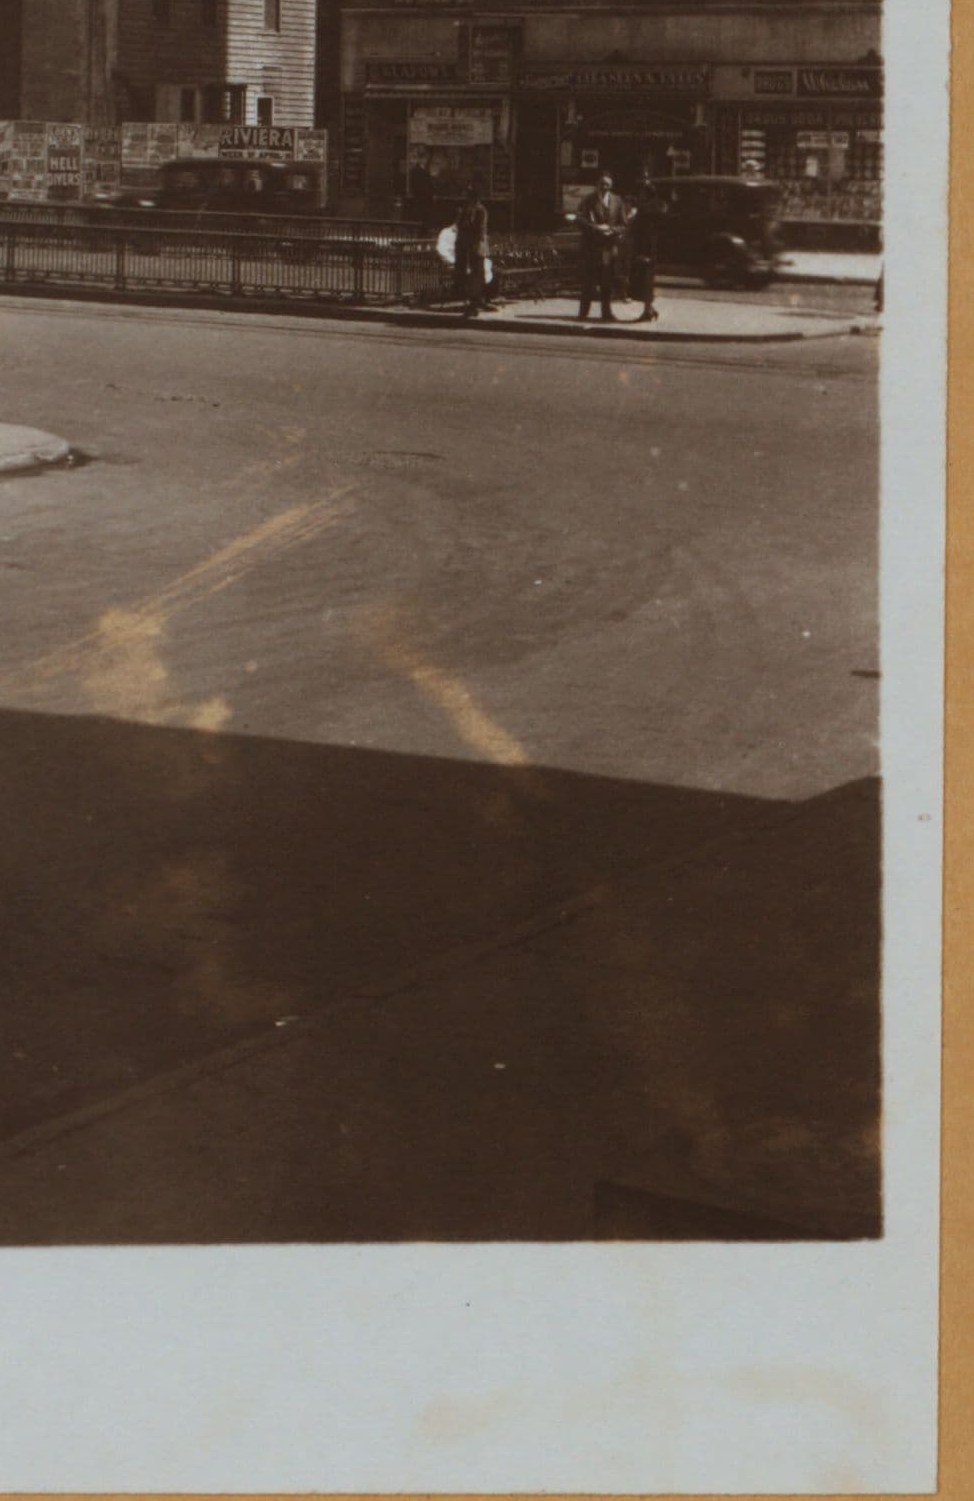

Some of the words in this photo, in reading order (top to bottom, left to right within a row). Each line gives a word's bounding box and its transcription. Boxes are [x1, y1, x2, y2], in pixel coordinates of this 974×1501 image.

[221, 127, 293, 147] RIVIERA
[49, 156, 77, 171] HELL
[46, 173, 81, 187] DIVERS
